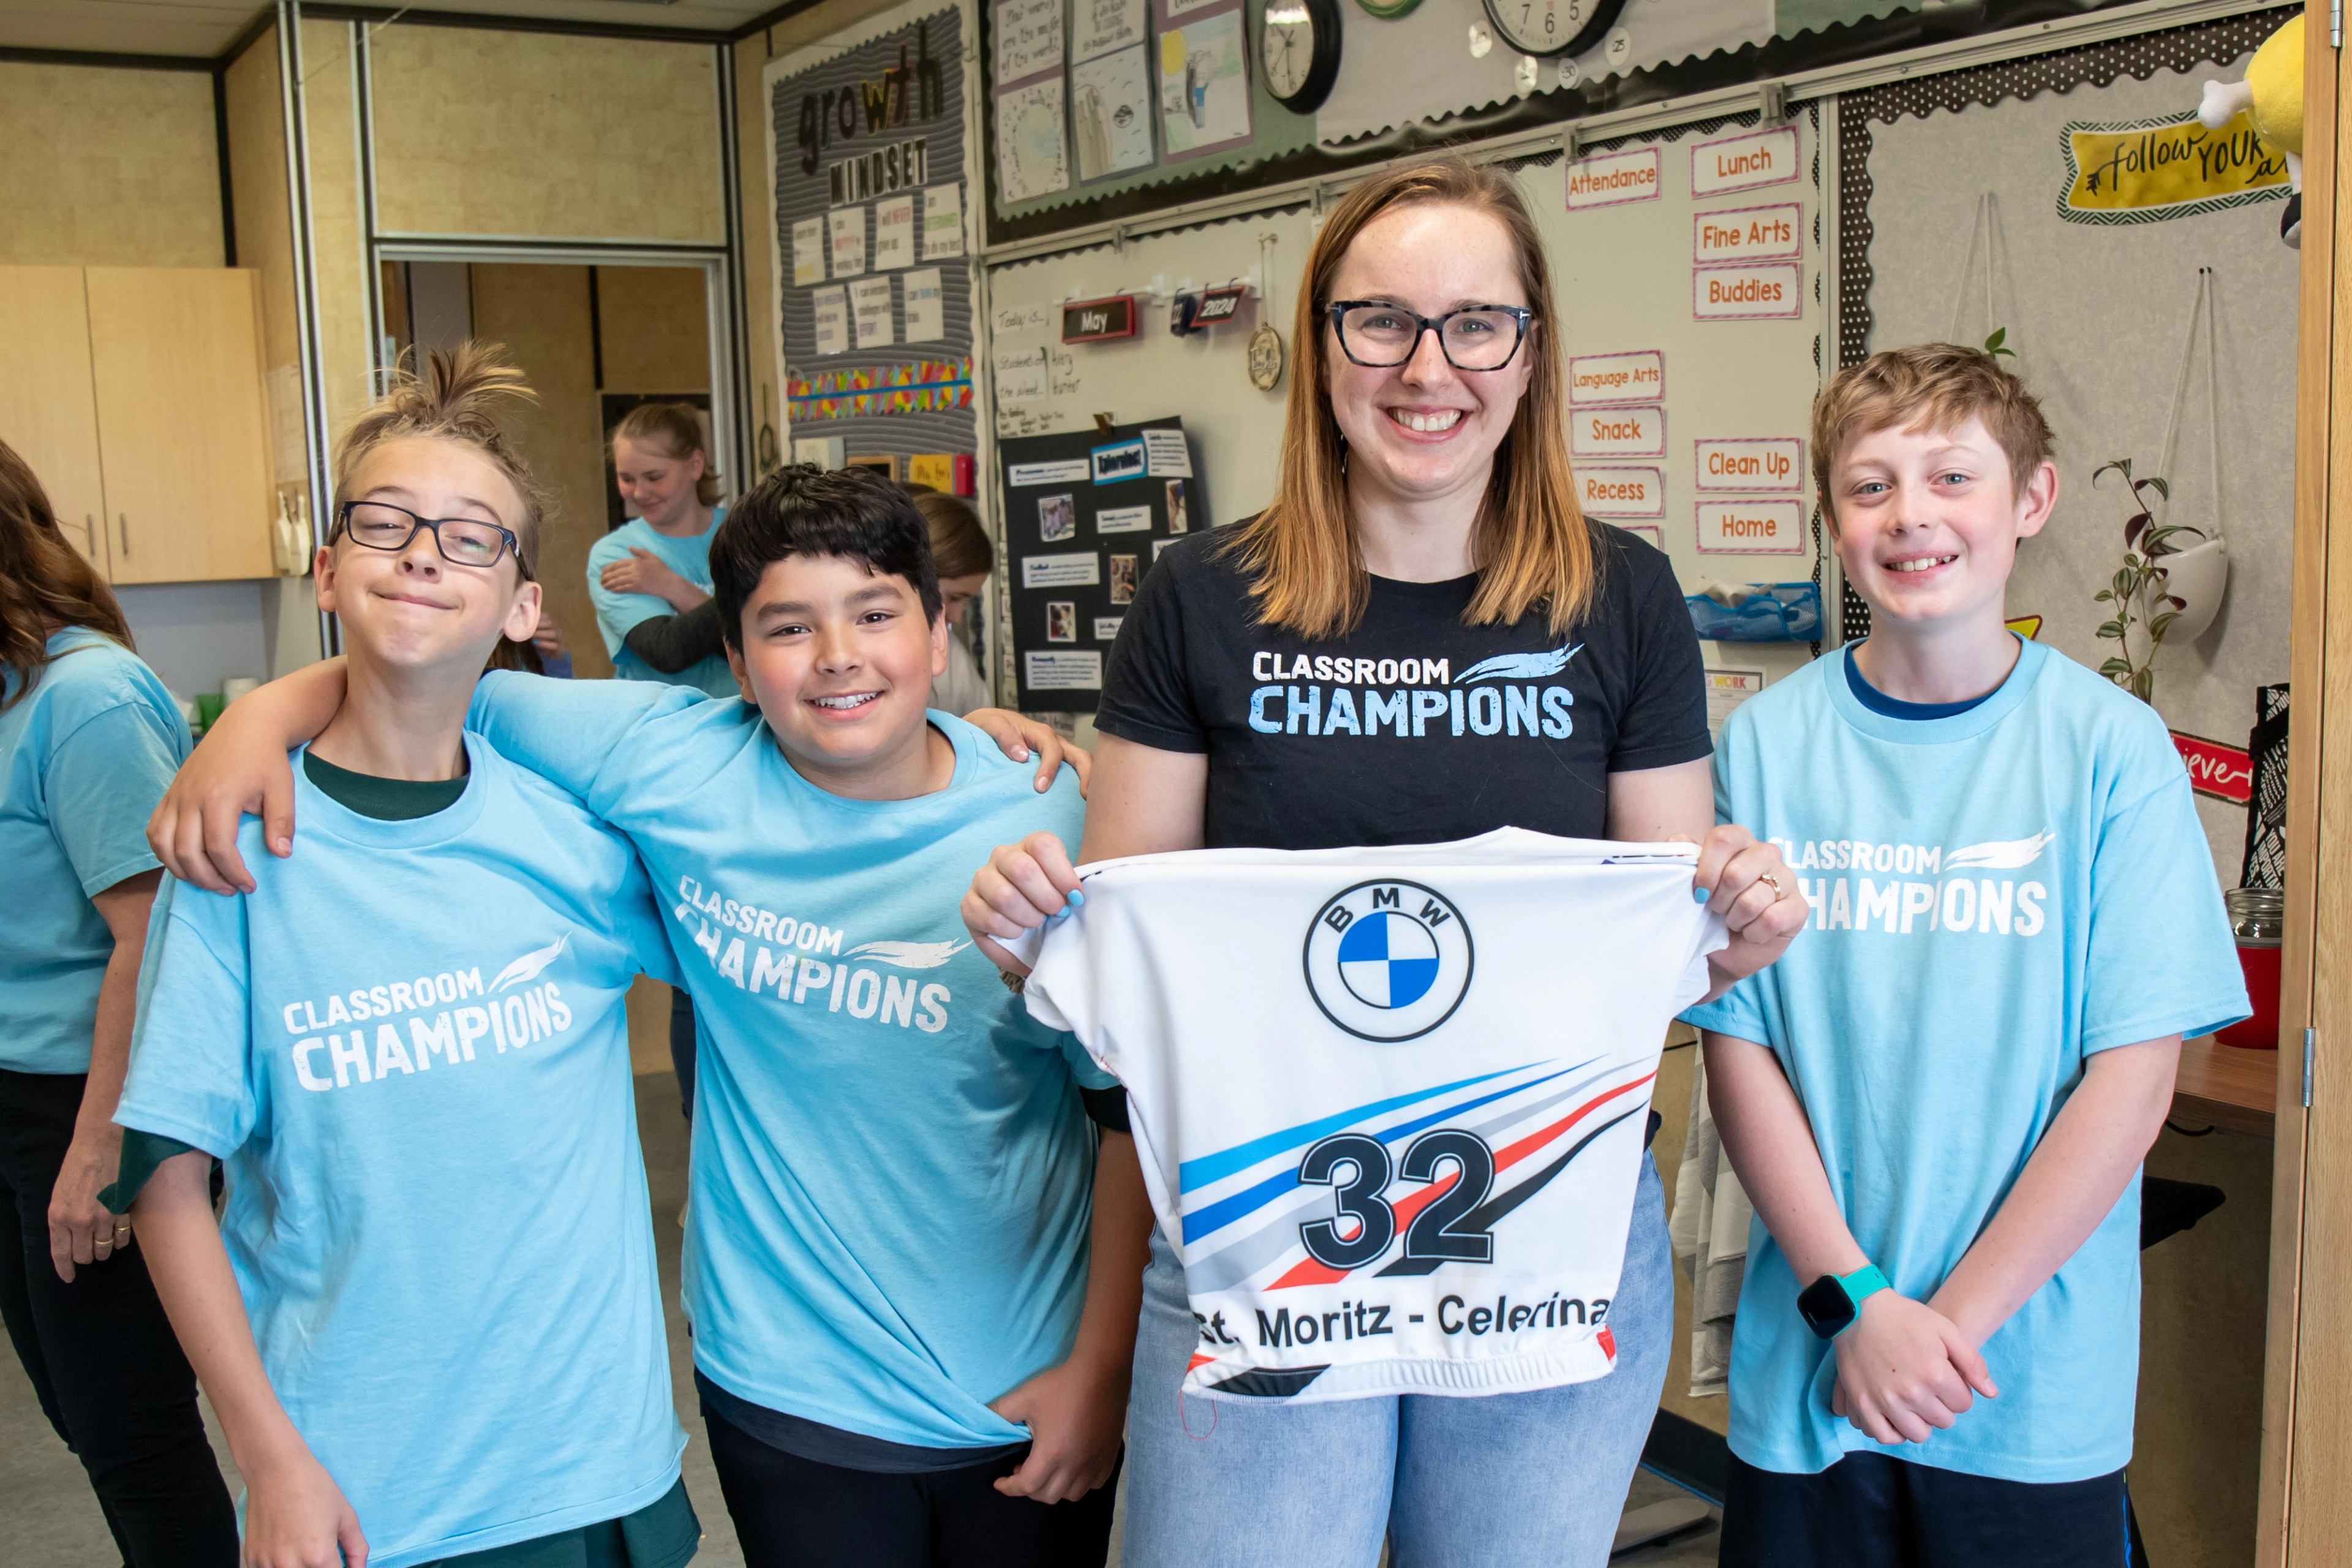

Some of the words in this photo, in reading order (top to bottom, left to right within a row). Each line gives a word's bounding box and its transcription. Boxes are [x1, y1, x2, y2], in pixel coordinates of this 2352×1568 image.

[1521, 4, 1531, 24] 7
[1545, 12, 1555, 34] 6
[798, 21, 943, 176] growth
[829, 137, 928, 206] MINDSET
[1717, 146, 1771, 178] Lunch
[2113, 130, 2208, 192] follow
[1569, 167, 1655, 195] Attendance
[1703, 225, 1741, 249] Fine
[1747, 219, 1790, 245] Arts
[1709, 279, 1782, 303] Buddies
[1081, 311, 1107, 334] May
[1574, 369, 1628, 389] Language
[1633, 367, 1659, 383] Arts
[1593, 418, 1641, 440] Snack
[1708, 452, 1760, 475] Clean
[1766, 452, 1789, 480] Up
[1587, 478, 1645, 500] Recess
[1722, 514, 1776, 537] Home
[1253, 651, 1449, 685] CLASSROOM
[1714, 676, 1746, 690] WORK
[1248, 685, 1574, 739] CHAMPIONS
[2172, 737, 2253, 787] ieve
[1768, 837, 1941, 874] LASSROOM
[679, 875, 844, 957] CLASSROOM
[1324, 888, 1450, 933] BMW
[1798, 878, 2047, 937] HAMPIONS
[283, 967, 484, 1035] CLASSROOM
[292, 982, 572, 1091] CHAMPIONS
[1297, 1128, 1496, 1271] 32
[1256, 1301, 1393, 1347] Moritz
[1438, 1291, 1610, 1335] Celerina
